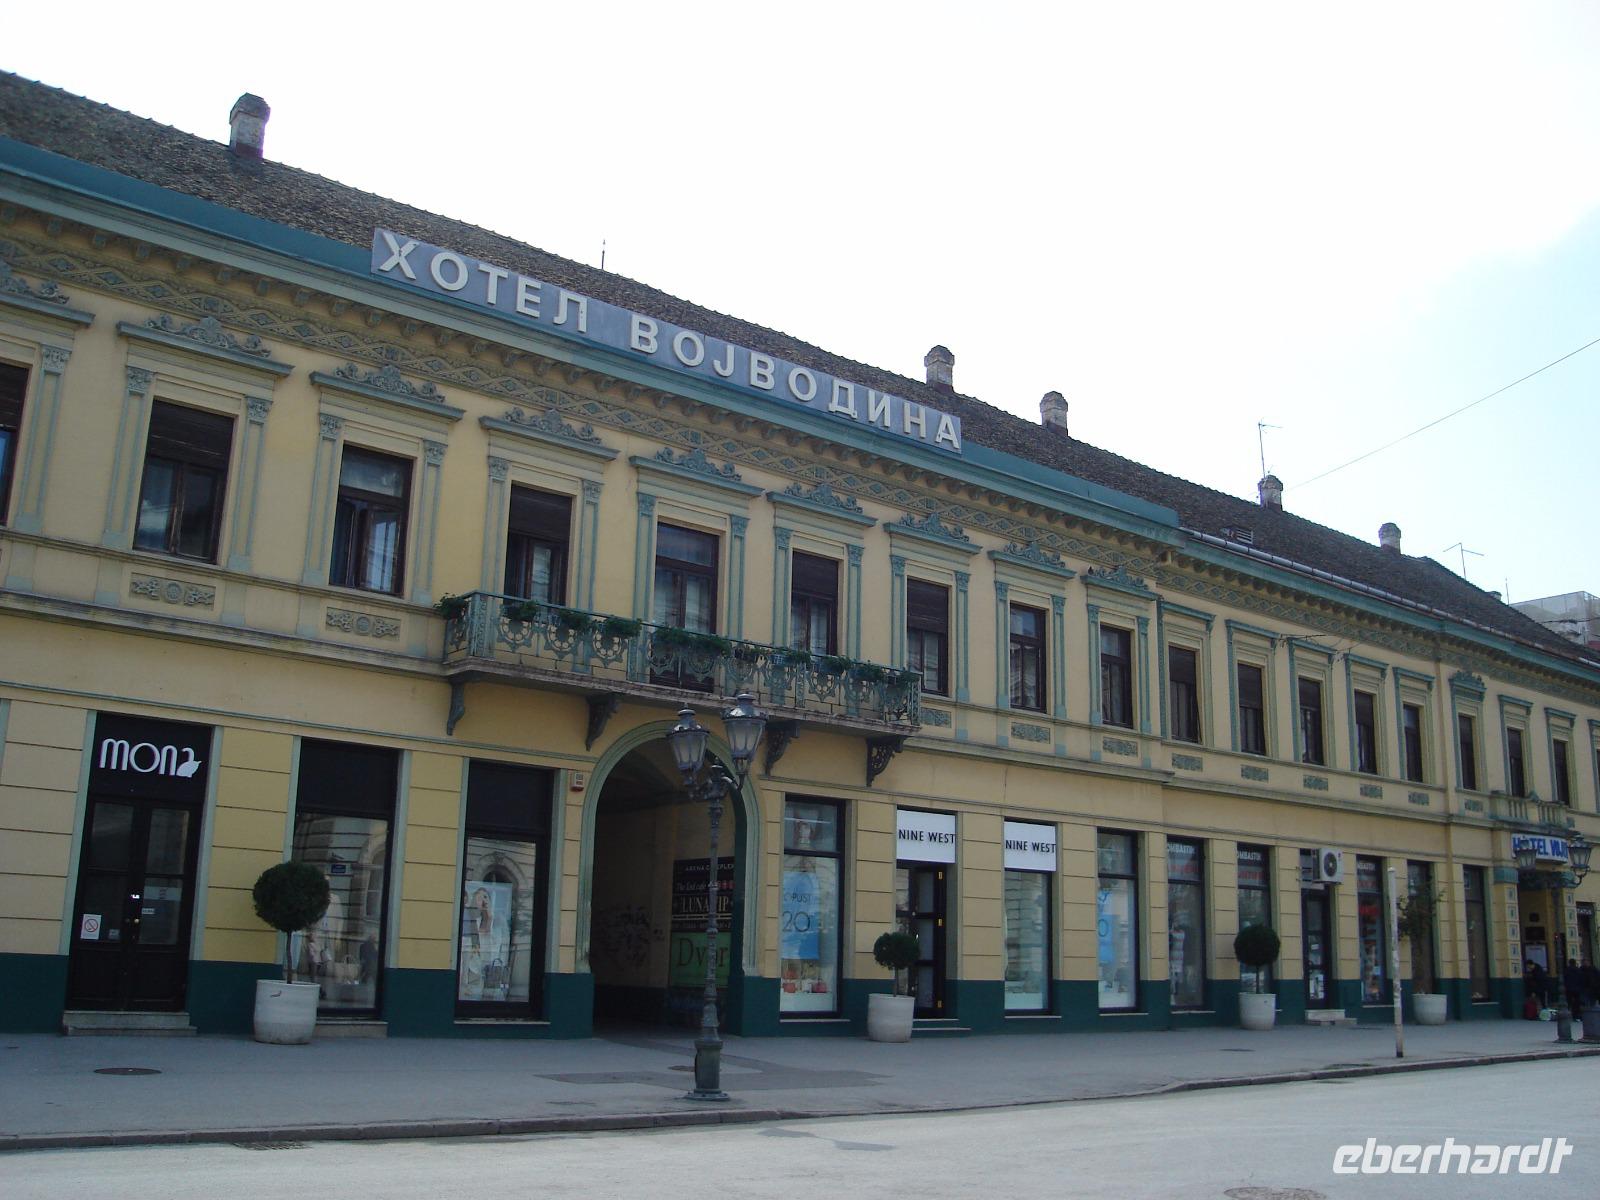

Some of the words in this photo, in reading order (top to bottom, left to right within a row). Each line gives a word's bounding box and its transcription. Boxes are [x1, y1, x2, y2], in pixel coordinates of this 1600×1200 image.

[378, 230, 588, 334] ХОТЕЛ
[629, 313, 961, 450] ВОЈВОДИНА
[898, 829, 924, 842] NINE
[928, 831, 956, 844] WEST
[1005, 839, 1028, 851] NINE
[1031, 842, 1057, 854] WEST
[1512, 837, 1549, 856] HTEL
[678, 937, 728, 967] Dvr
